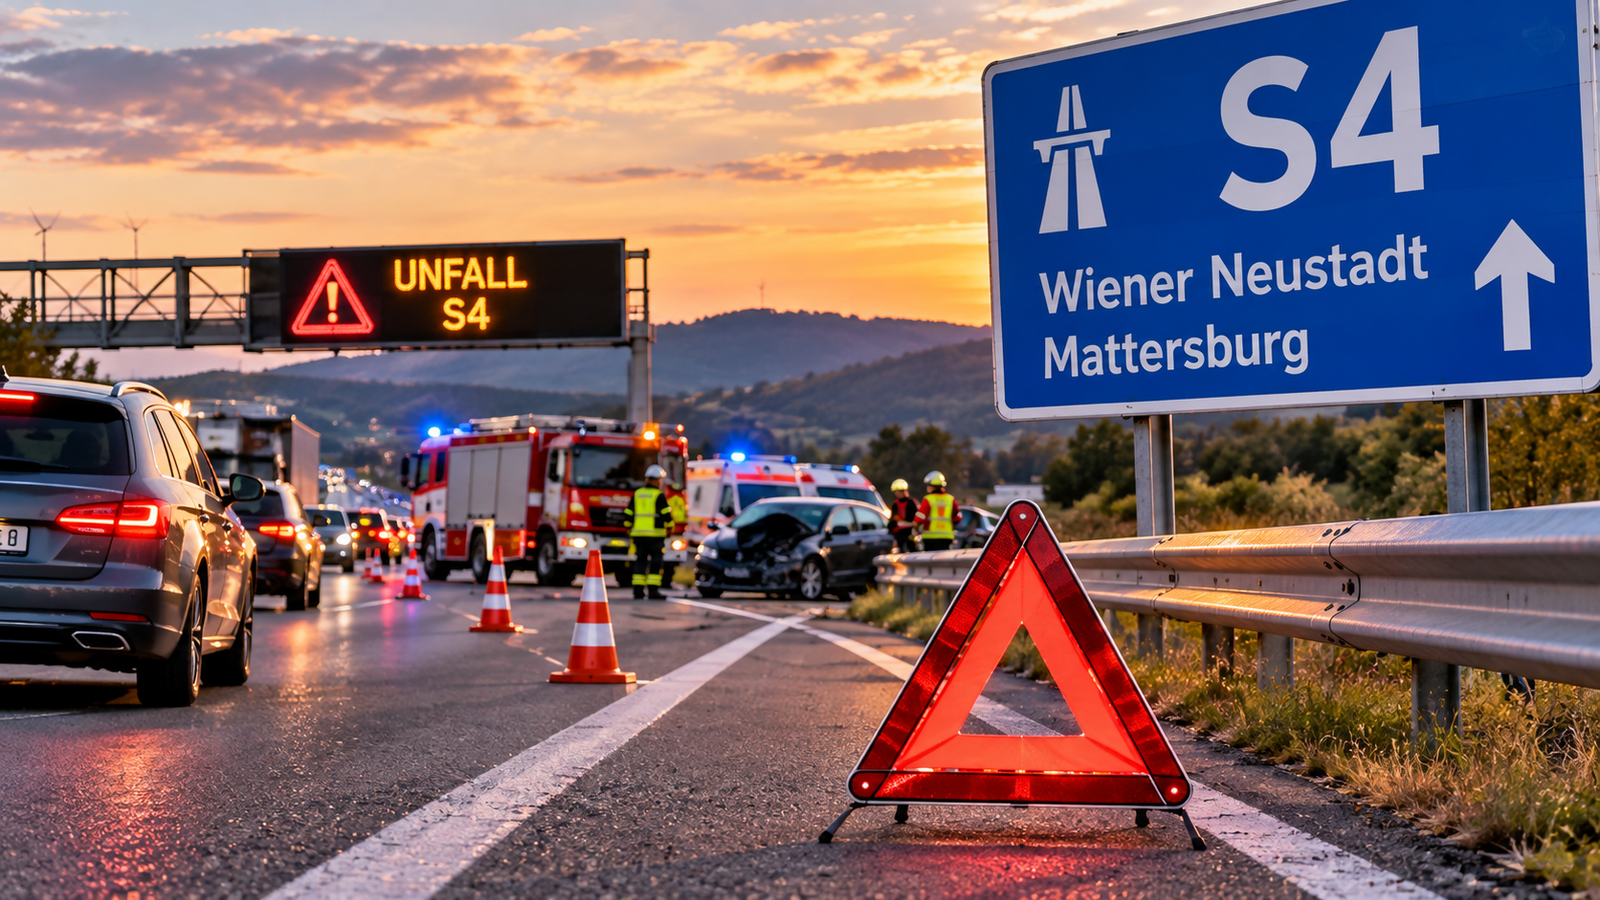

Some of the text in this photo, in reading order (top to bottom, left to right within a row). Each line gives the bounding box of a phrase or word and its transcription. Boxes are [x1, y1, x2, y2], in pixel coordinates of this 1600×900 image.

[1219, 26, 1440, 212] S4
[394, 256, 528, 292] UNFALL
[1039, 234, 1429, 314] Wiener Neustadt
[442, 297, 491, 331] S4
[1044, 324, 1309, 378] Mattersburg
